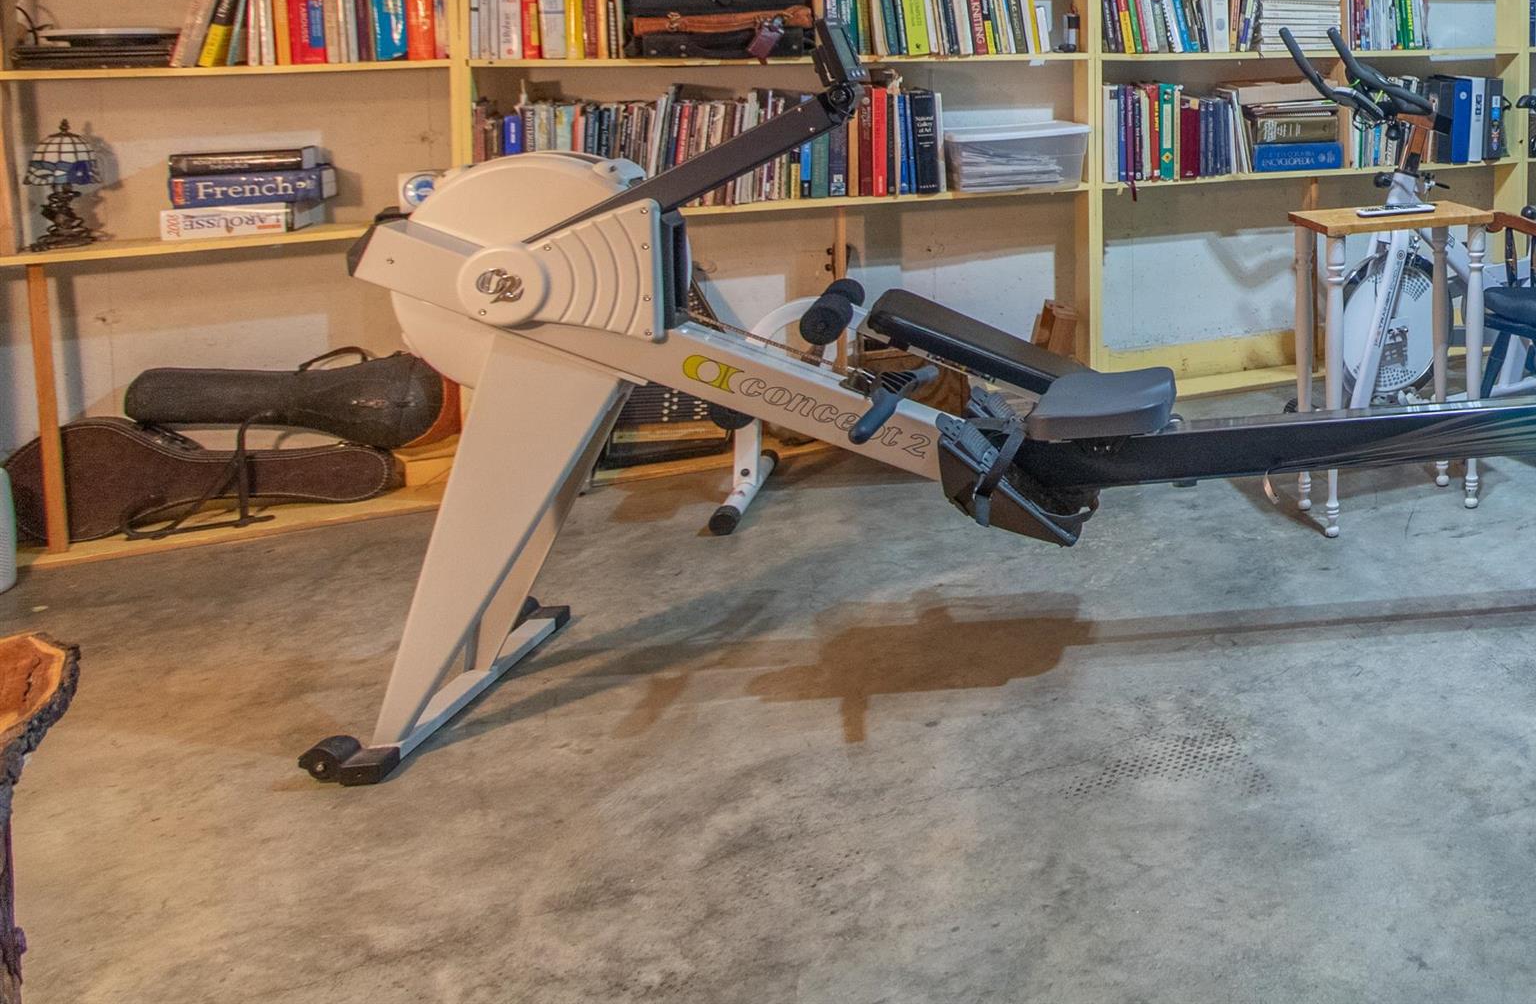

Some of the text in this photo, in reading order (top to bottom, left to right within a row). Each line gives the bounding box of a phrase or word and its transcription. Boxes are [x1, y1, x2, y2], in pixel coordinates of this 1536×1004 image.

[971, 2, 985, 44] KNITTING
[195, 176, 295, 200] French
[182, 213, 281, 232] LAROUSSE
[902, 432, 932, 459] 2
